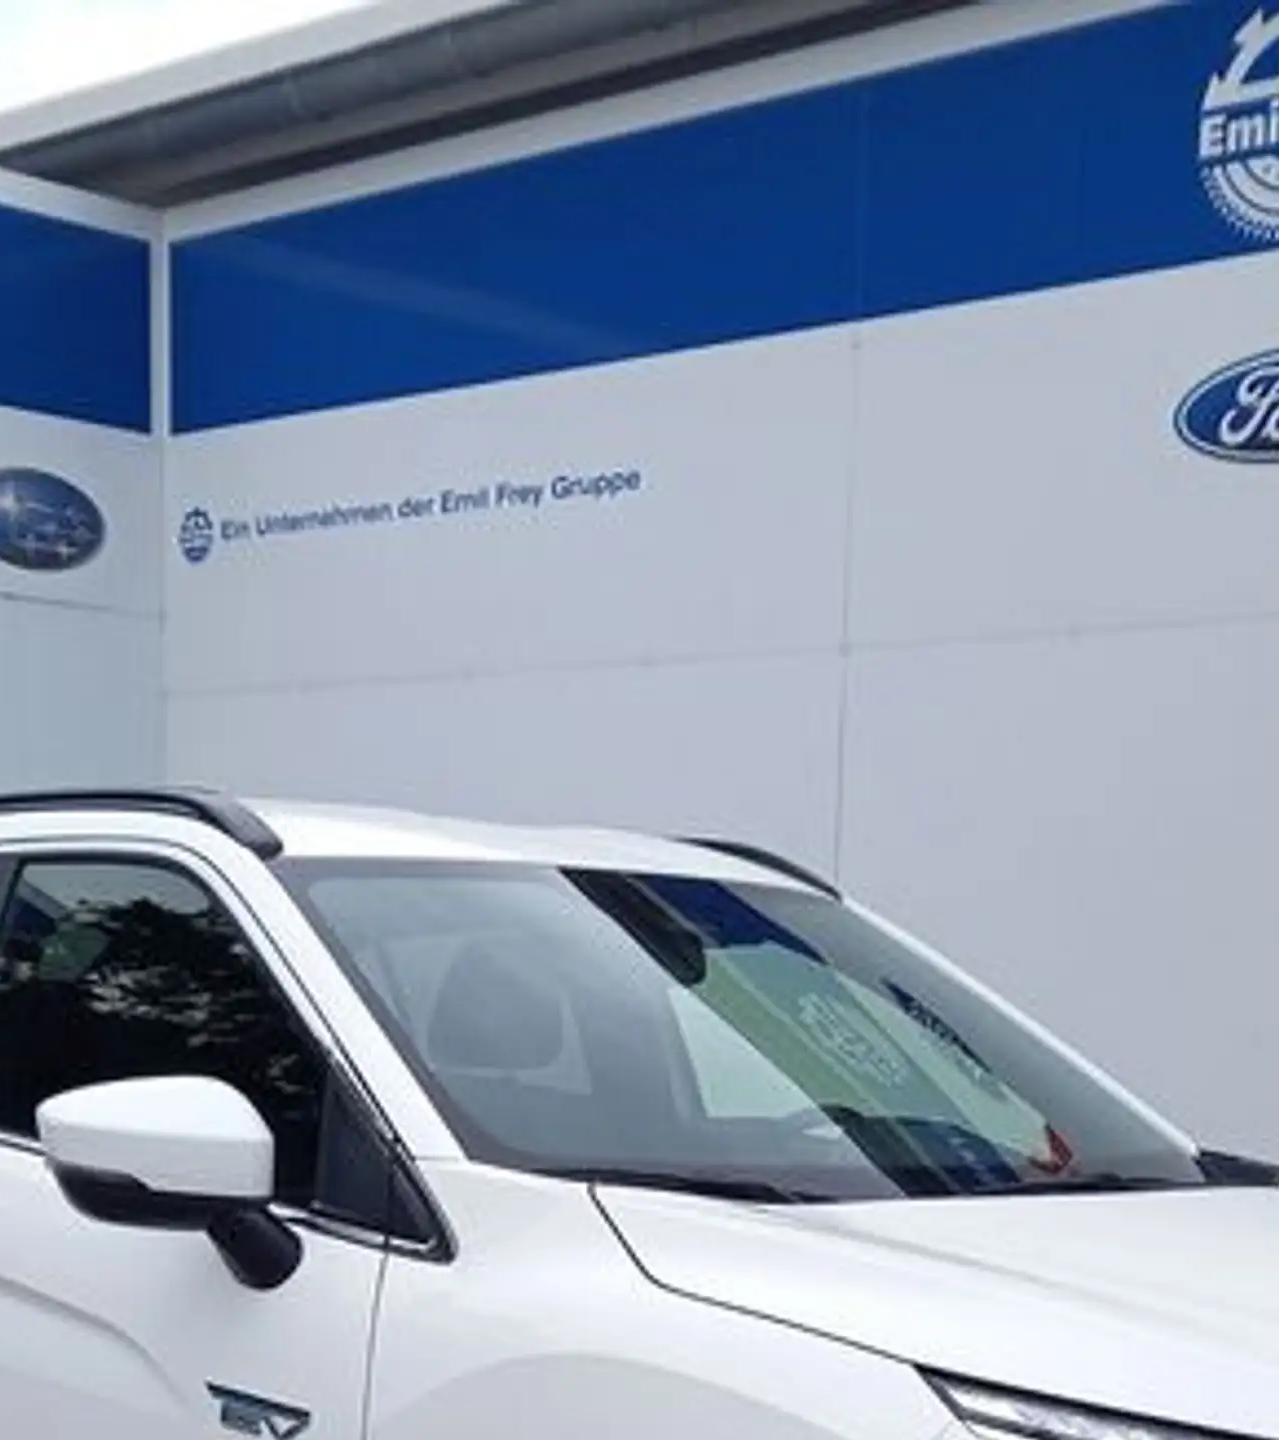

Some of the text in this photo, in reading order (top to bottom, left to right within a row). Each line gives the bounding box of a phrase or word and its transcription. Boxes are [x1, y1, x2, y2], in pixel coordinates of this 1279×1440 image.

[440, 486, 491, 515] Emil
[495, 480, 544, 509] Frey
[551, 470, 642, 500] Gruppe
